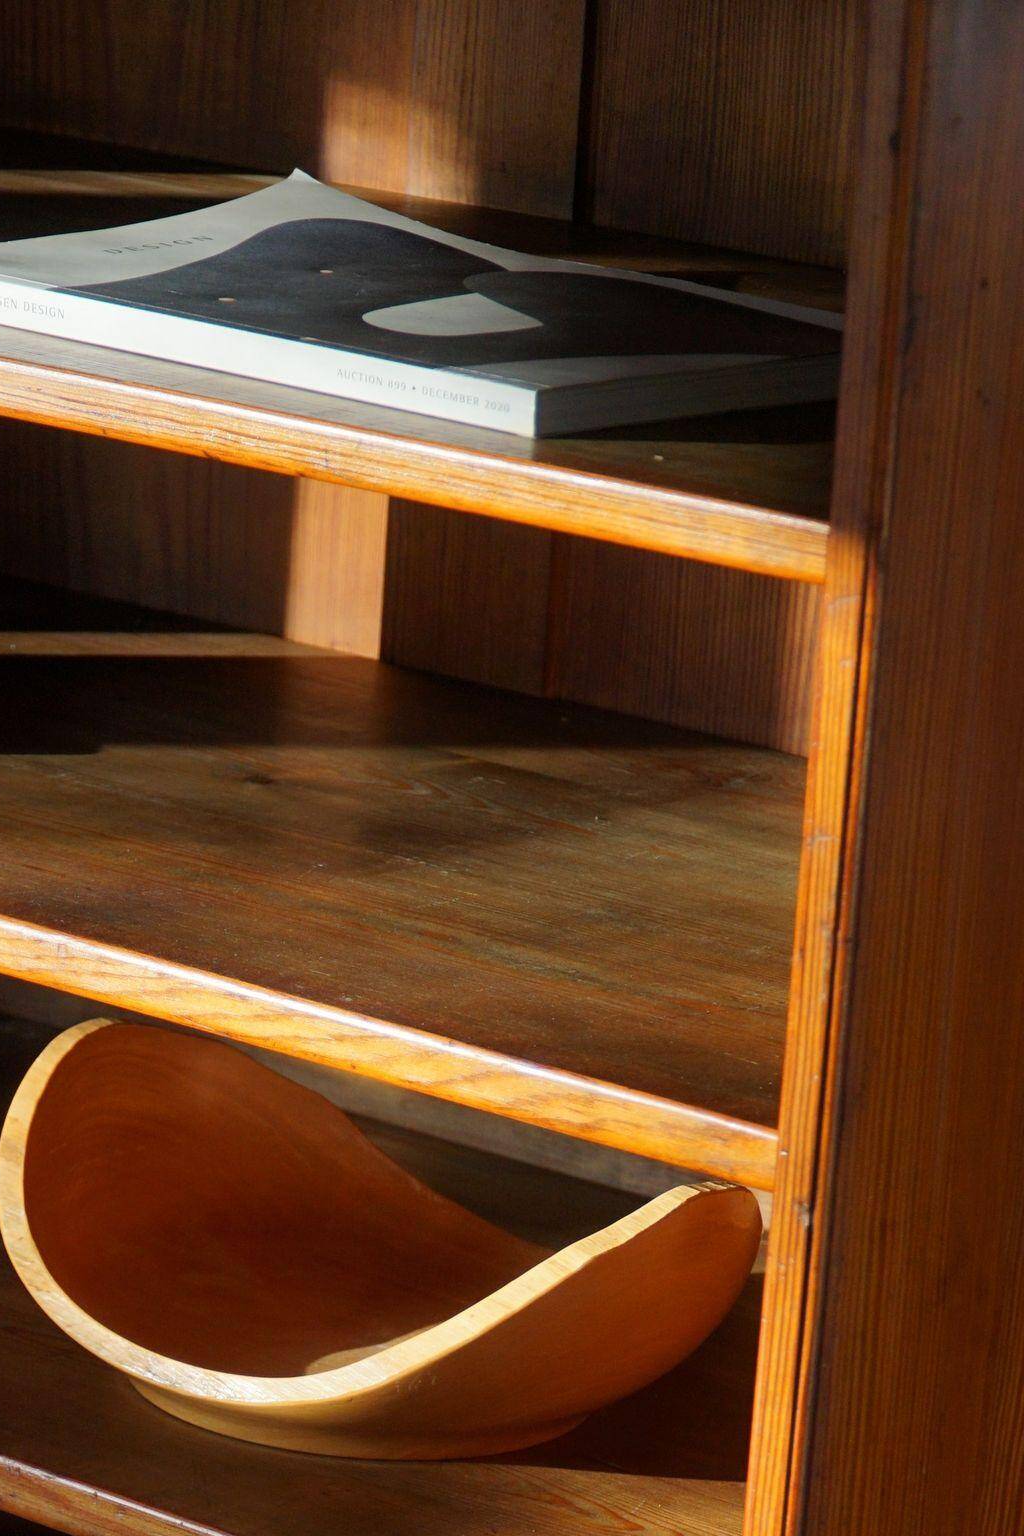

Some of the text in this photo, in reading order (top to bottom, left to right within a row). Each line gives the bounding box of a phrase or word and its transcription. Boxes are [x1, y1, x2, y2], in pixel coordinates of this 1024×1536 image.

[23, 301, 65, 319] DESIGN
[336, 368, 384, 387] AUCTION
[421, 386, 480, 408] DECEMBER
[484, 399, 511, 414] 2020
